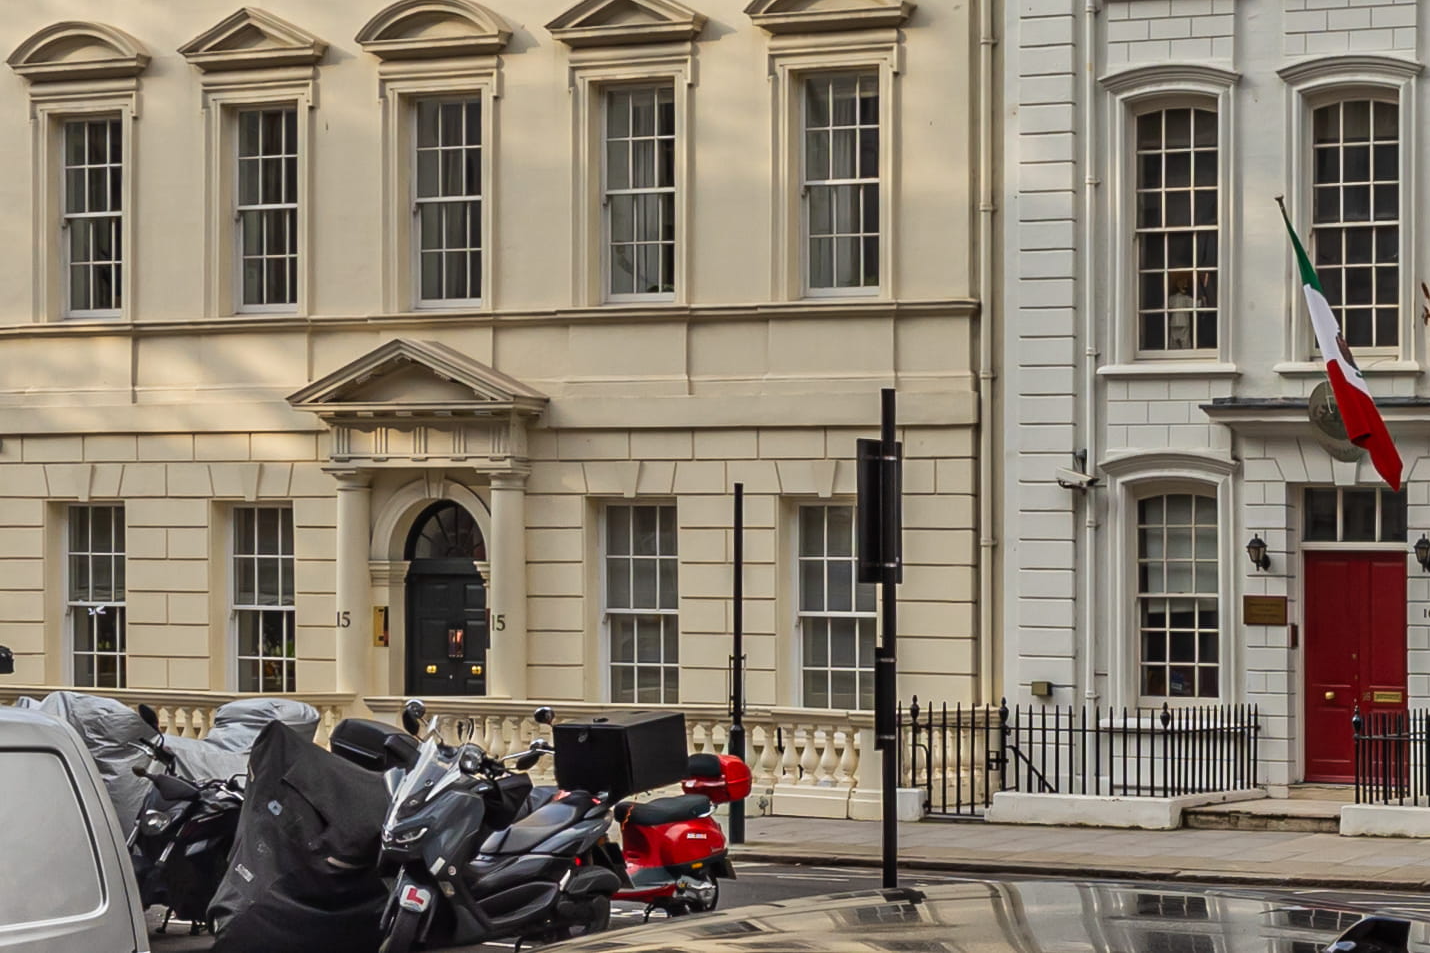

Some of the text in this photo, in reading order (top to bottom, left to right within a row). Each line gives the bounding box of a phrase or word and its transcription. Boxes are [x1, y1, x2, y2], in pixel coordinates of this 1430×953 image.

[336, 611, 351, 628] 15
[491, 614, 506, 632] 15
[407, 888, 425, 905] L
